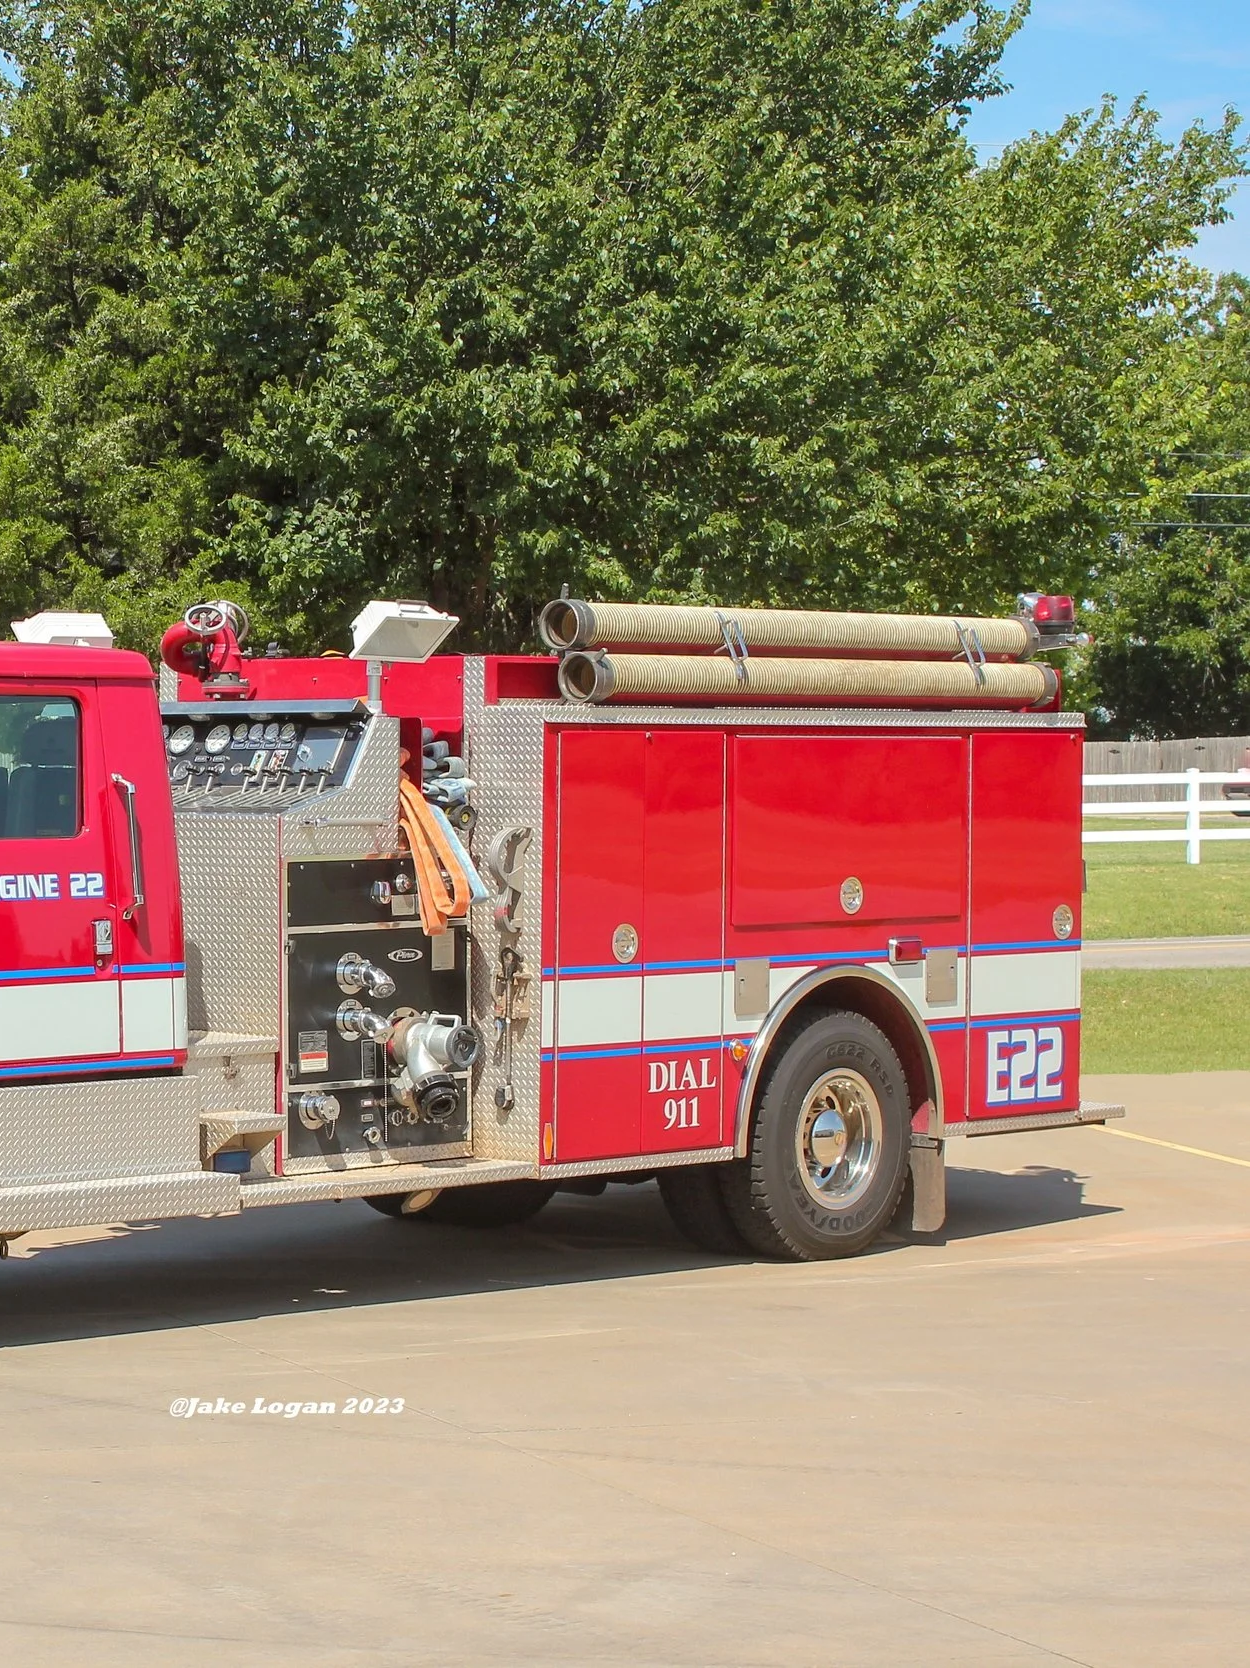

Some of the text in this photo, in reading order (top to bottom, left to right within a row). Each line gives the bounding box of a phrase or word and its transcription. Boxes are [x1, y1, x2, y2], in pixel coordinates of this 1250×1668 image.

[69, 871, 105, 899] 22
[647, 1057, 717, 1094] DIAL
[985, 1025, 1064, 1107] E22
[663, 1096, 701, 1130] 911
